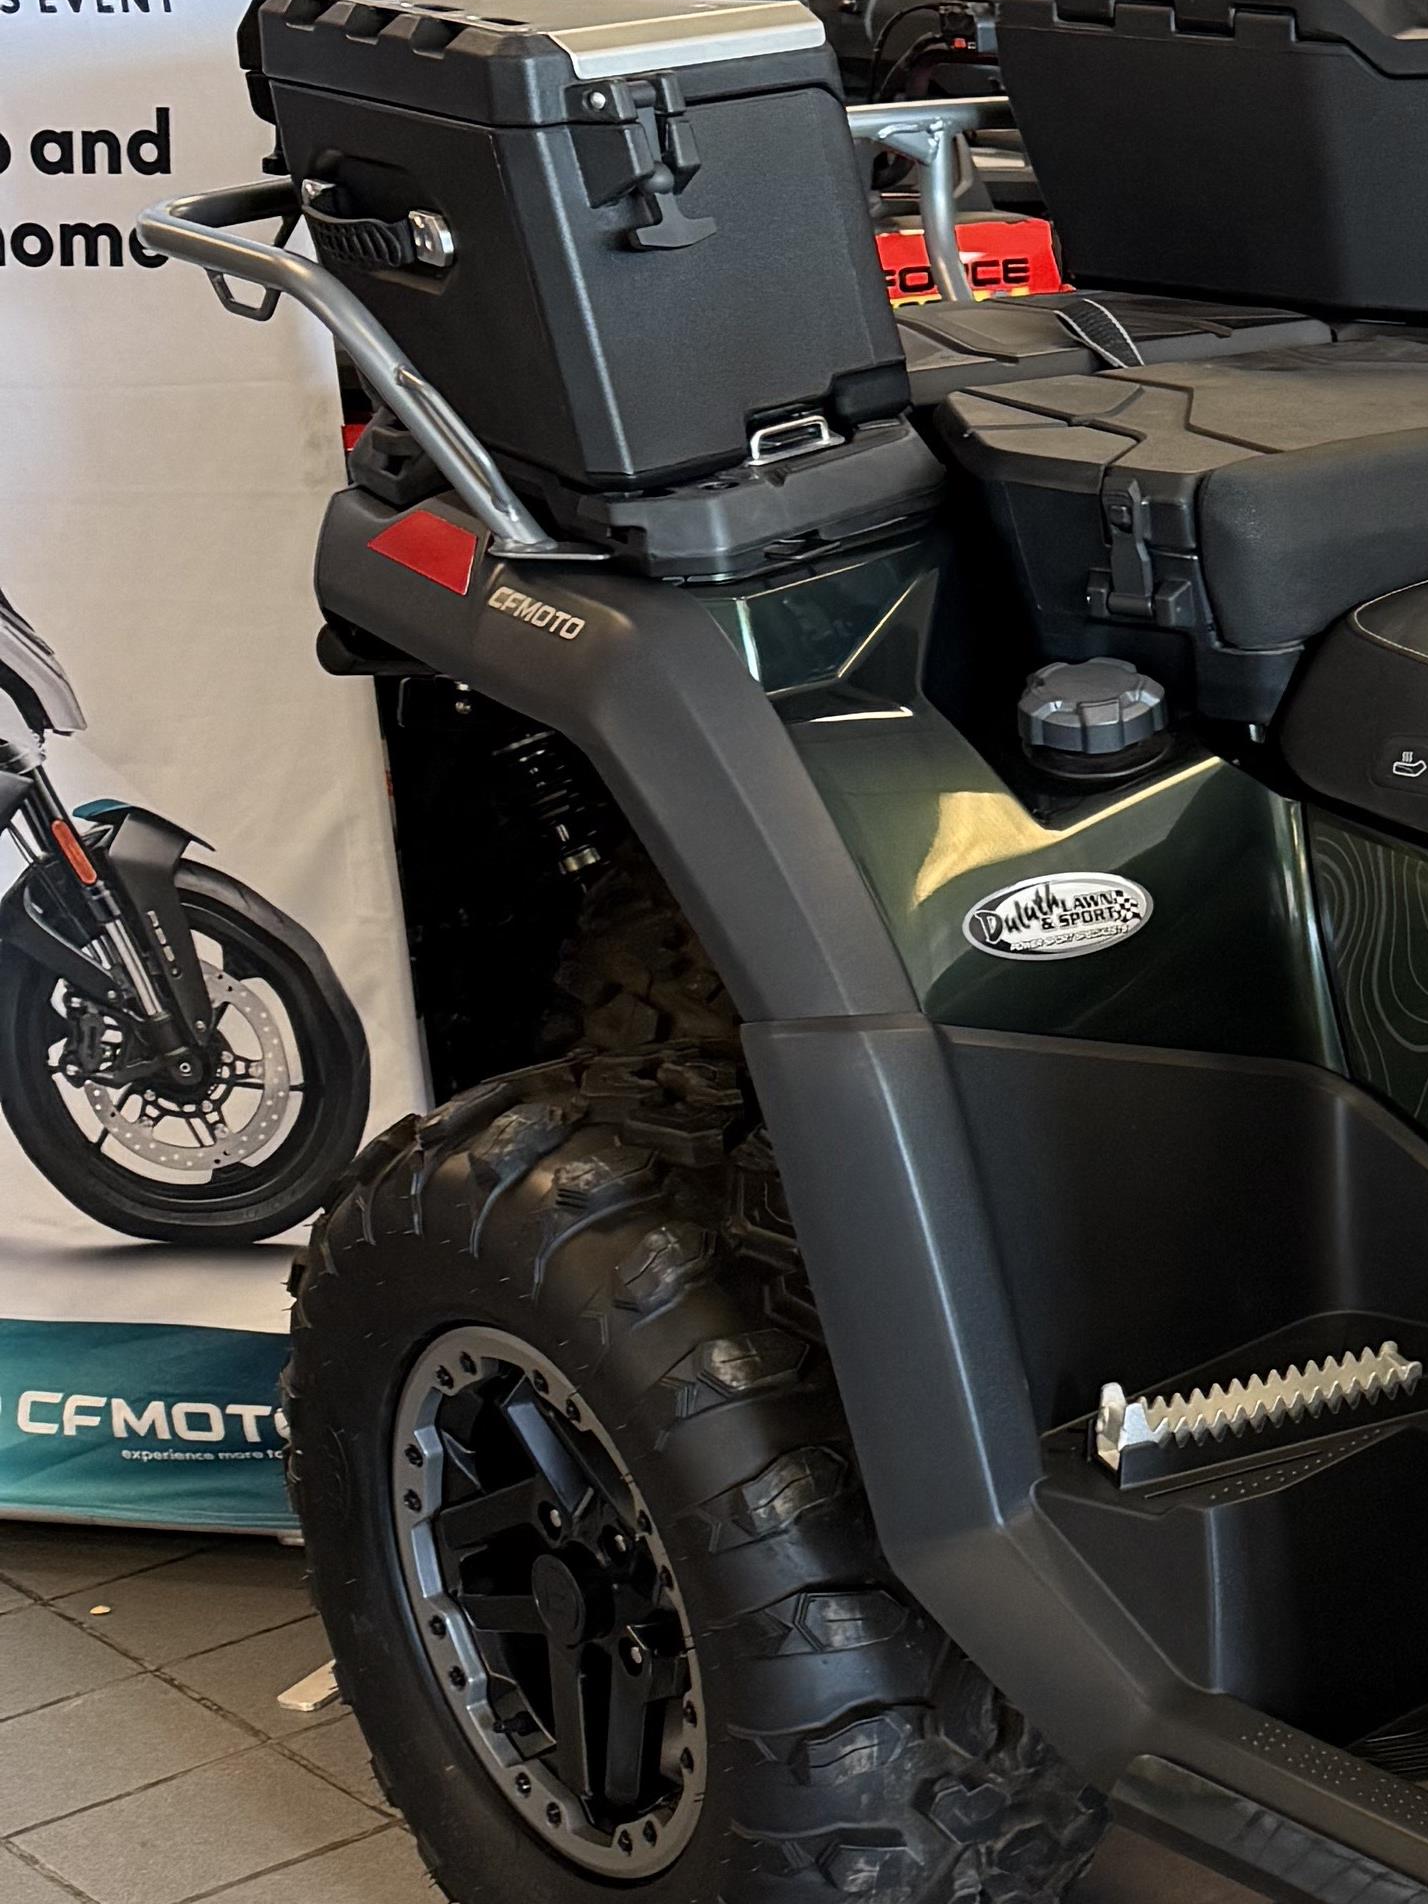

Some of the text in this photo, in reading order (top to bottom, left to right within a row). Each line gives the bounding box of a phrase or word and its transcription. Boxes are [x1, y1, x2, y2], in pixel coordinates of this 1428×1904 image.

[30, 107, 171, 175] and
[0, 223, 169, 268] om
[487, 586, 586, 640] CFMOTO
[975, 882, 1113, 945] Duluth LAWN
[1041, 915, 1055, 931] &
[121, 1448, 215, 1463] experience
[218, 1451, 263, 1461] more
